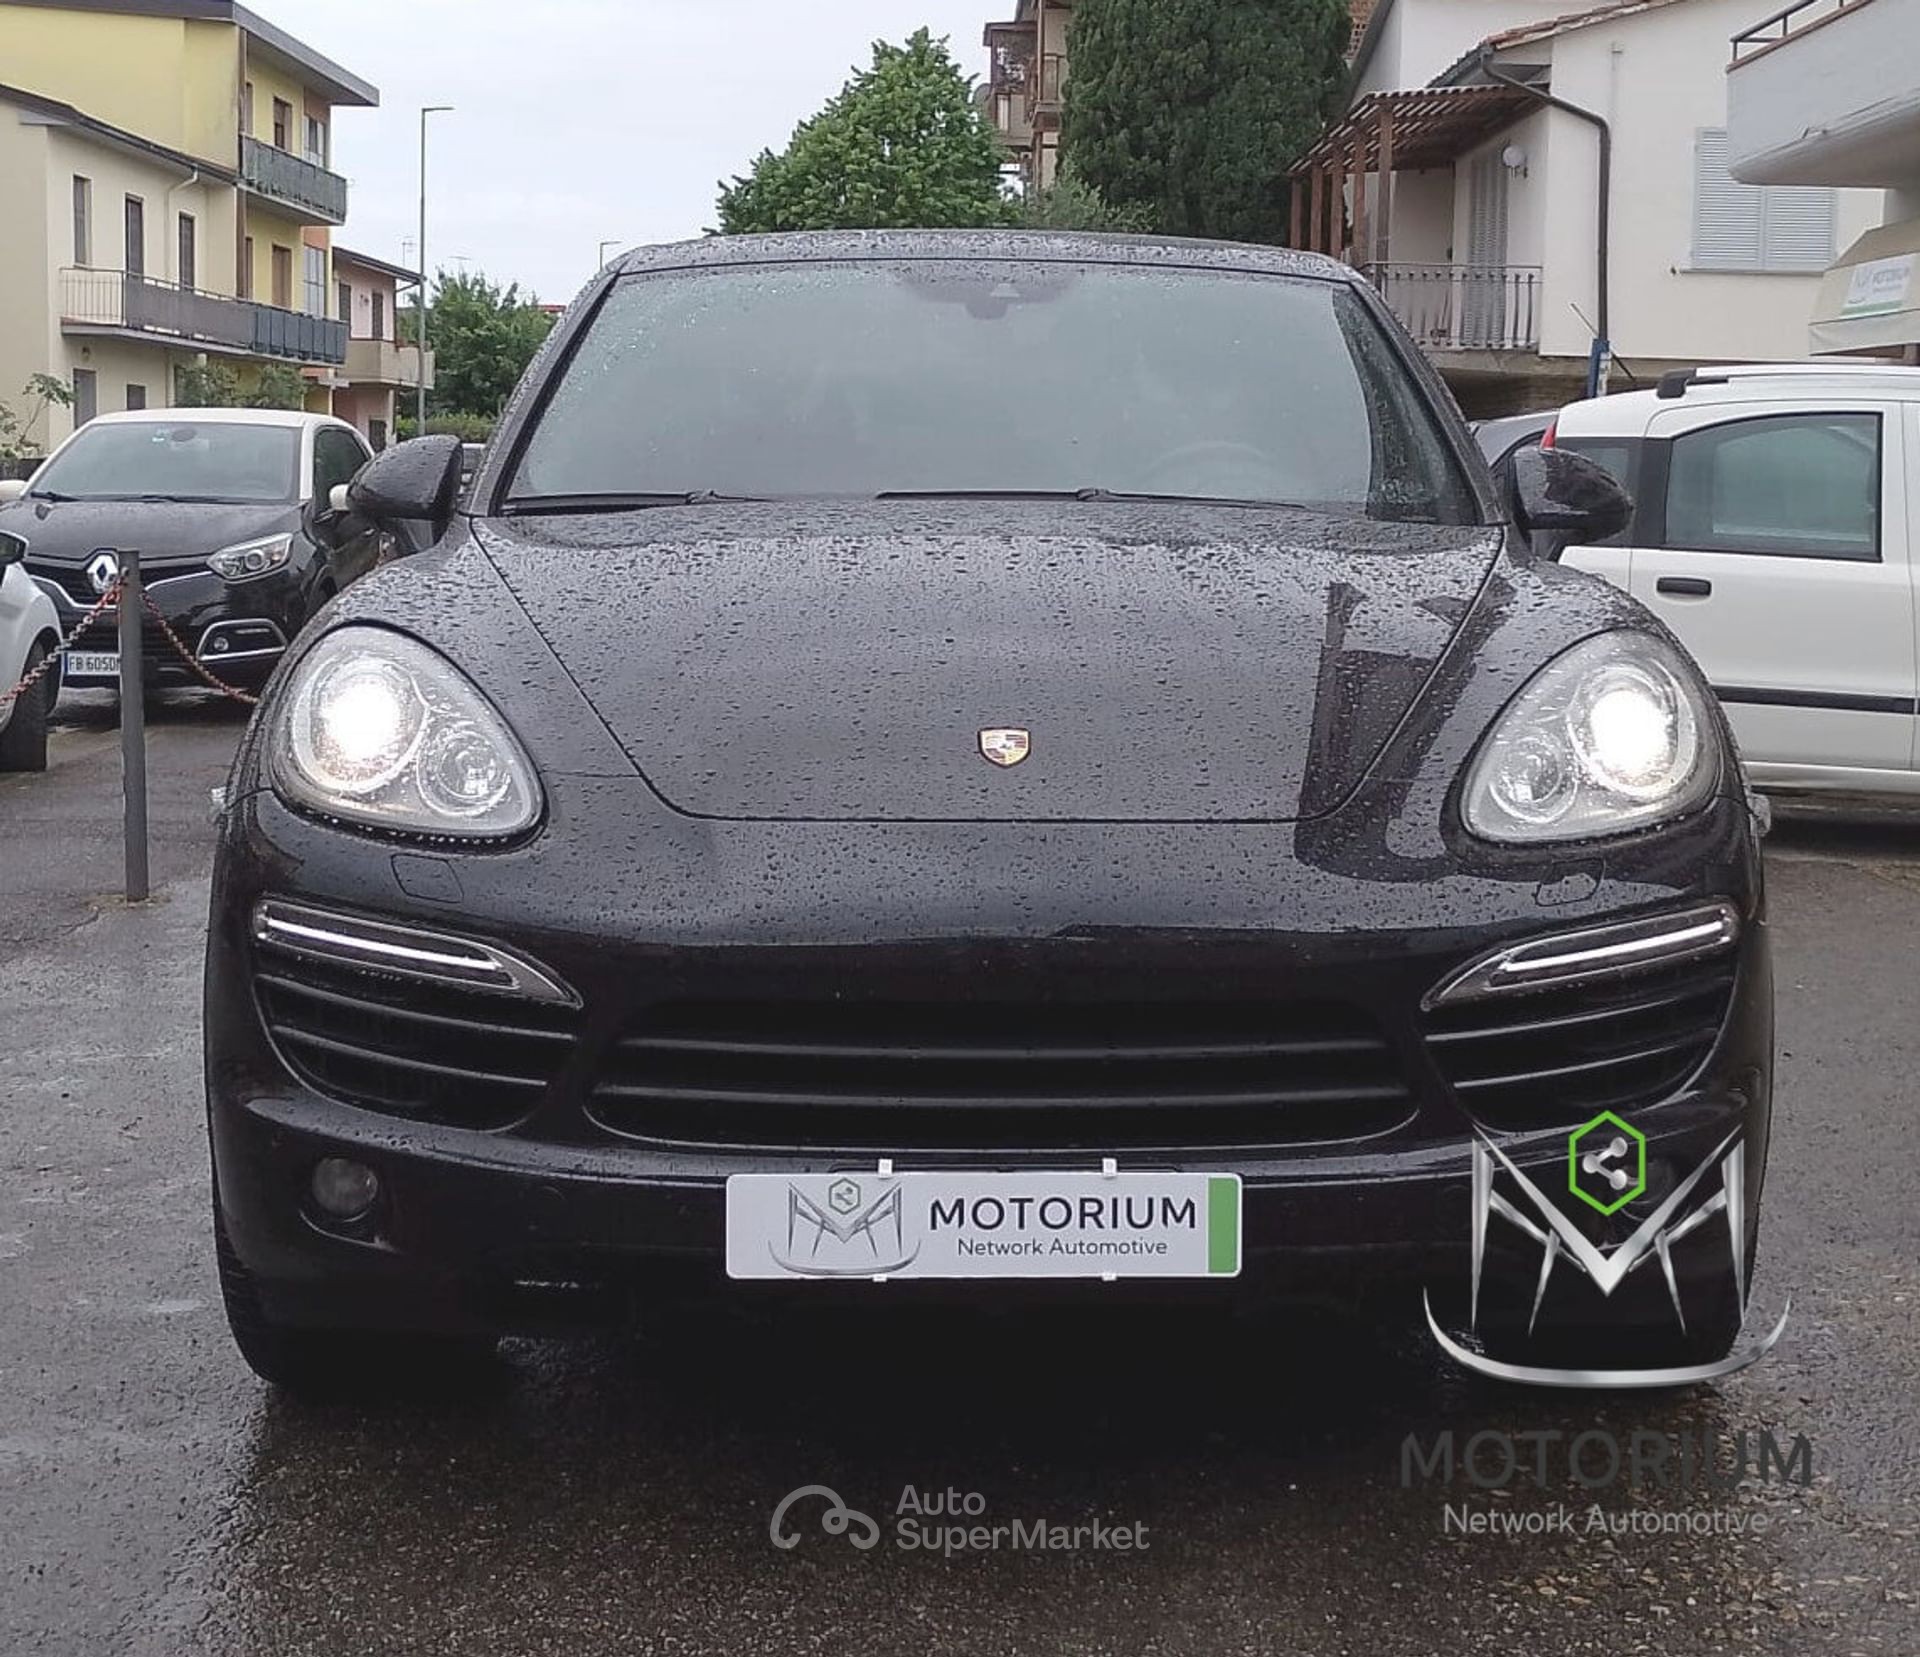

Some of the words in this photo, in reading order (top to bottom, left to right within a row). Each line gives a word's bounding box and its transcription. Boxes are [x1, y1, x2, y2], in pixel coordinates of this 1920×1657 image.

[69, 656, 84, 671] FB
[929, 1196, 1196, 1231] MOTORIUM
[957, 1238, 1044, 1256] Network
[1050, 1238, 1168, 1256] Automotive
